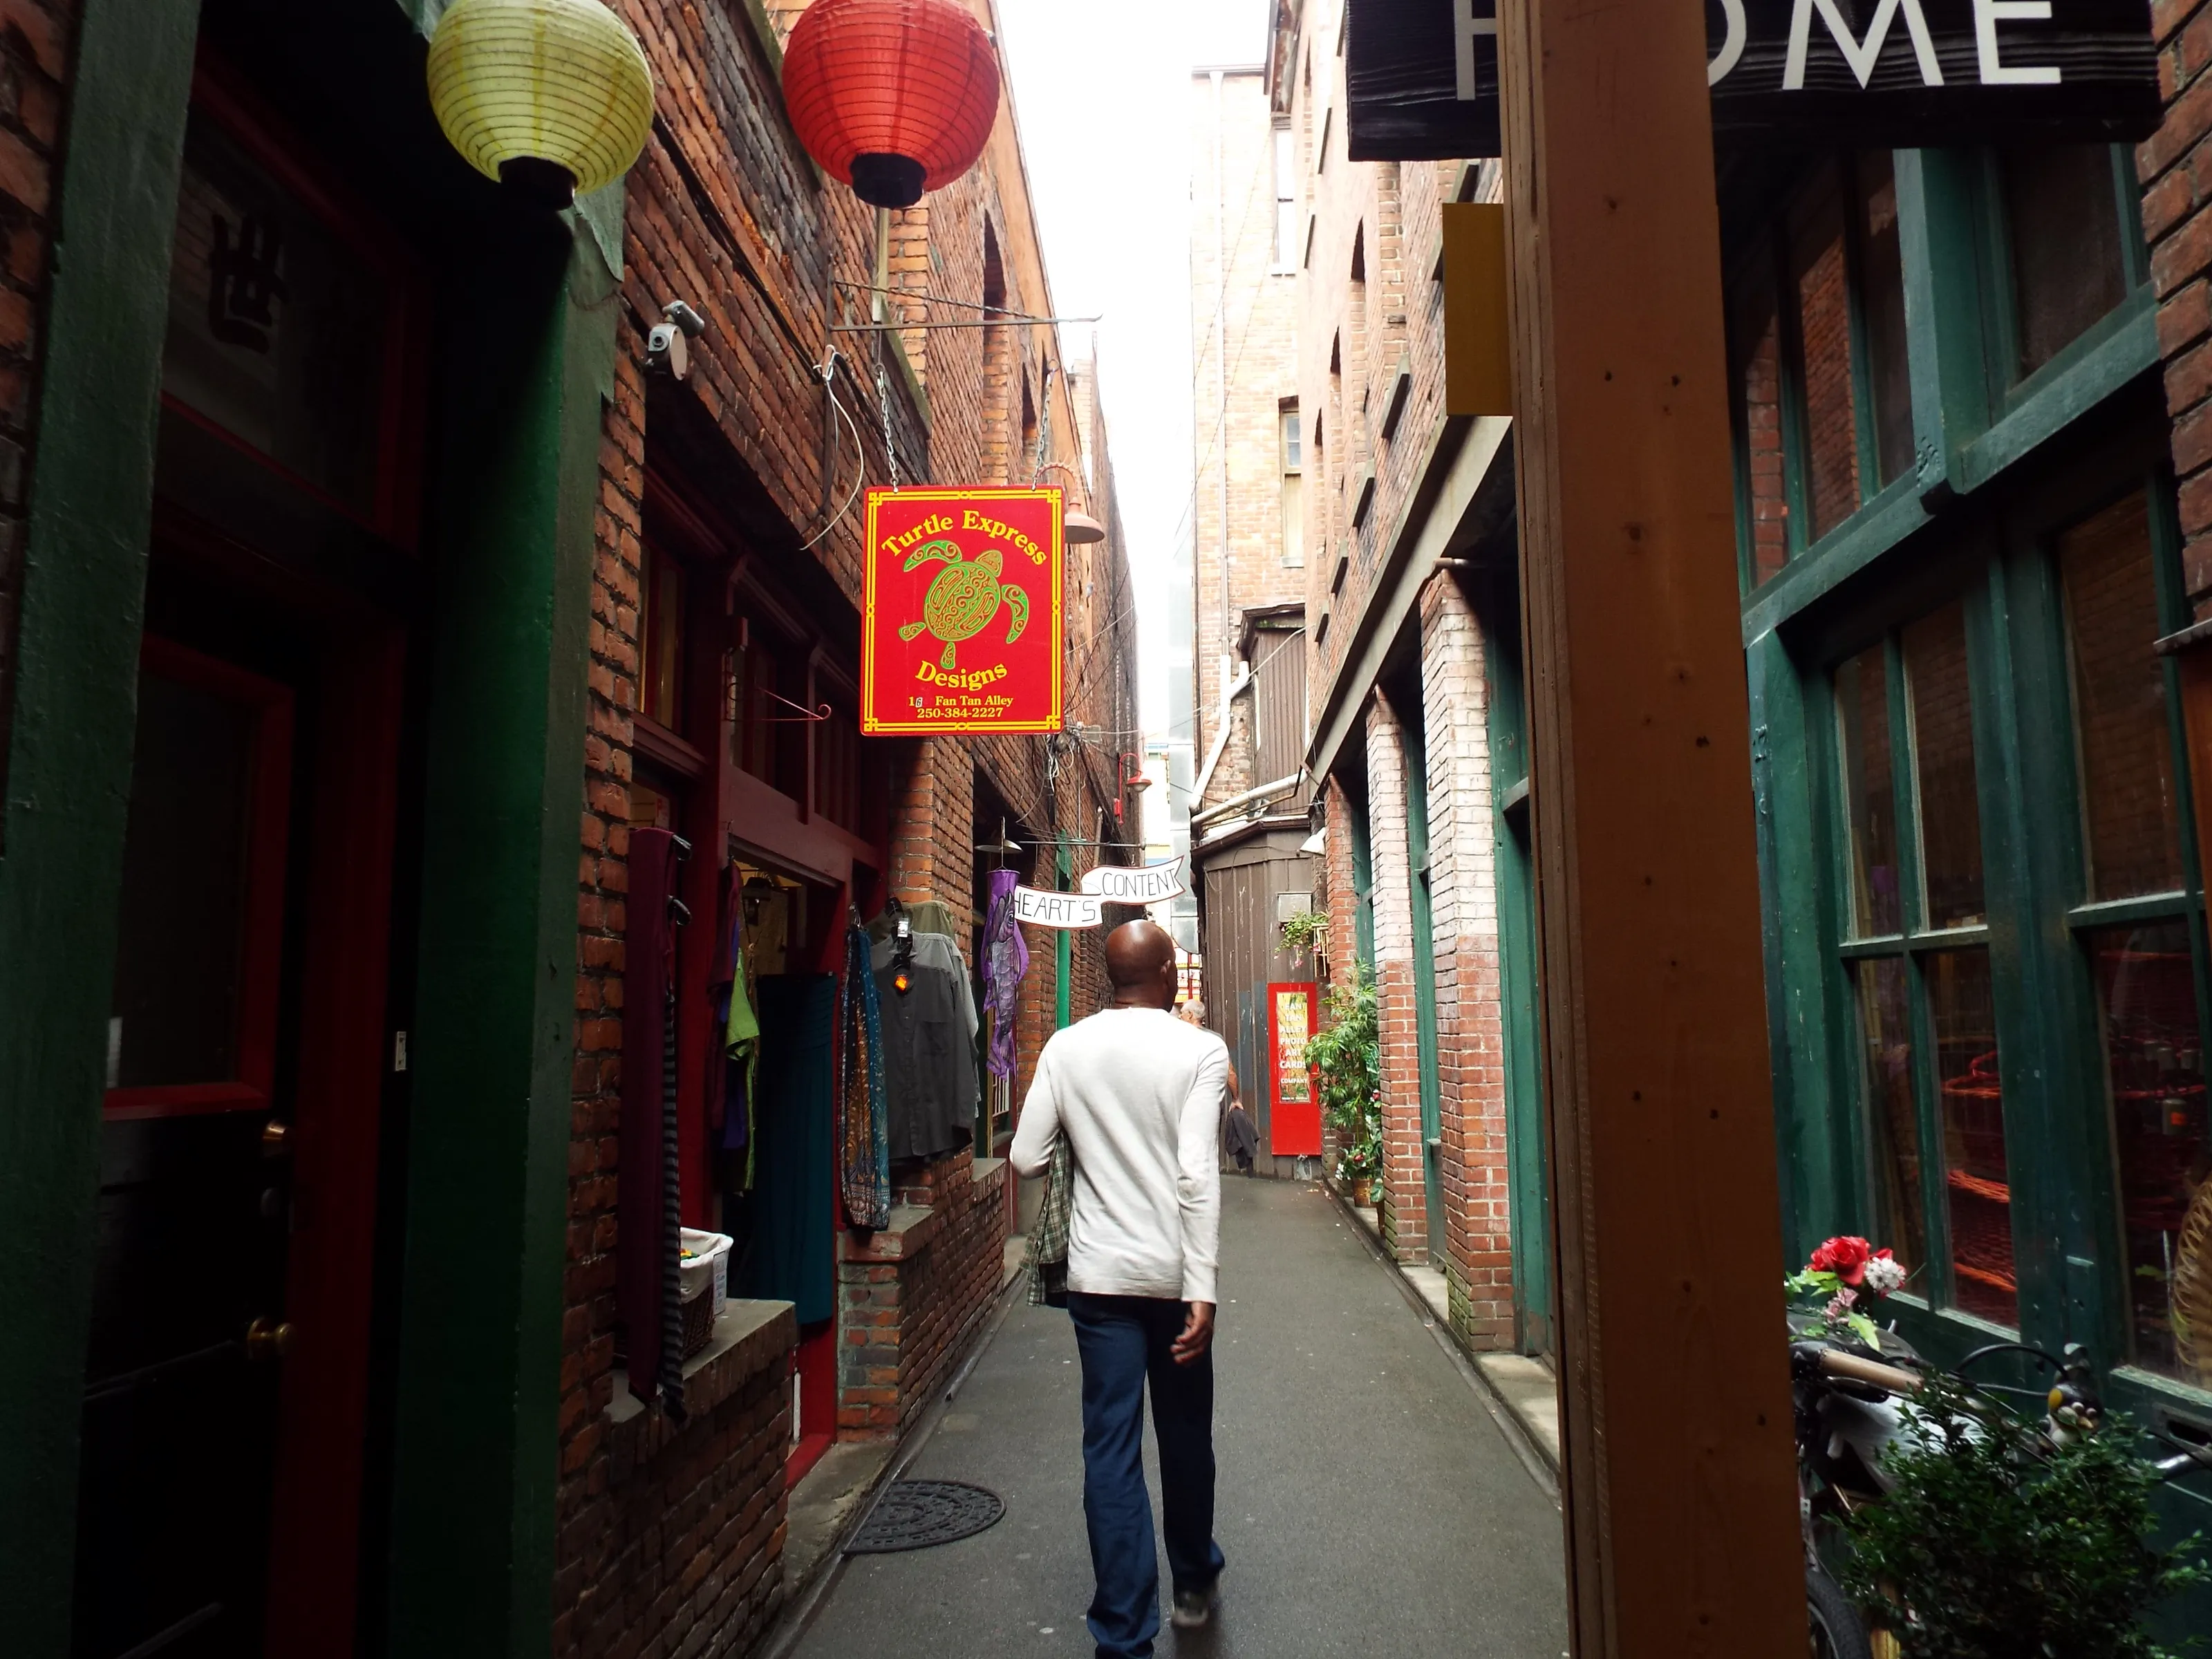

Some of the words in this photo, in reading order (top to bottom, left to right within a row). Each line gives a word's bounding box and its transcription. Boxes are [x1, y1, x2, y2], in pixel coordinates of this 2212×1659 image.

[1454, 0, 2061, 100] ME
[881, 514, 954, 557] Turtle
[962, 509, 1047, 565] Express
[915, 660, 1008, 691] Designs
[908, 696, 923, 708] 16
[935, 695, 957, 706] Fan
[959, 695, 982, 706] Tan
[984, 695, 1013, 706] Alley
[917, 707, 1004, 718] 250-384-2227
[1102, 868, 1177, 897] CONTENT
